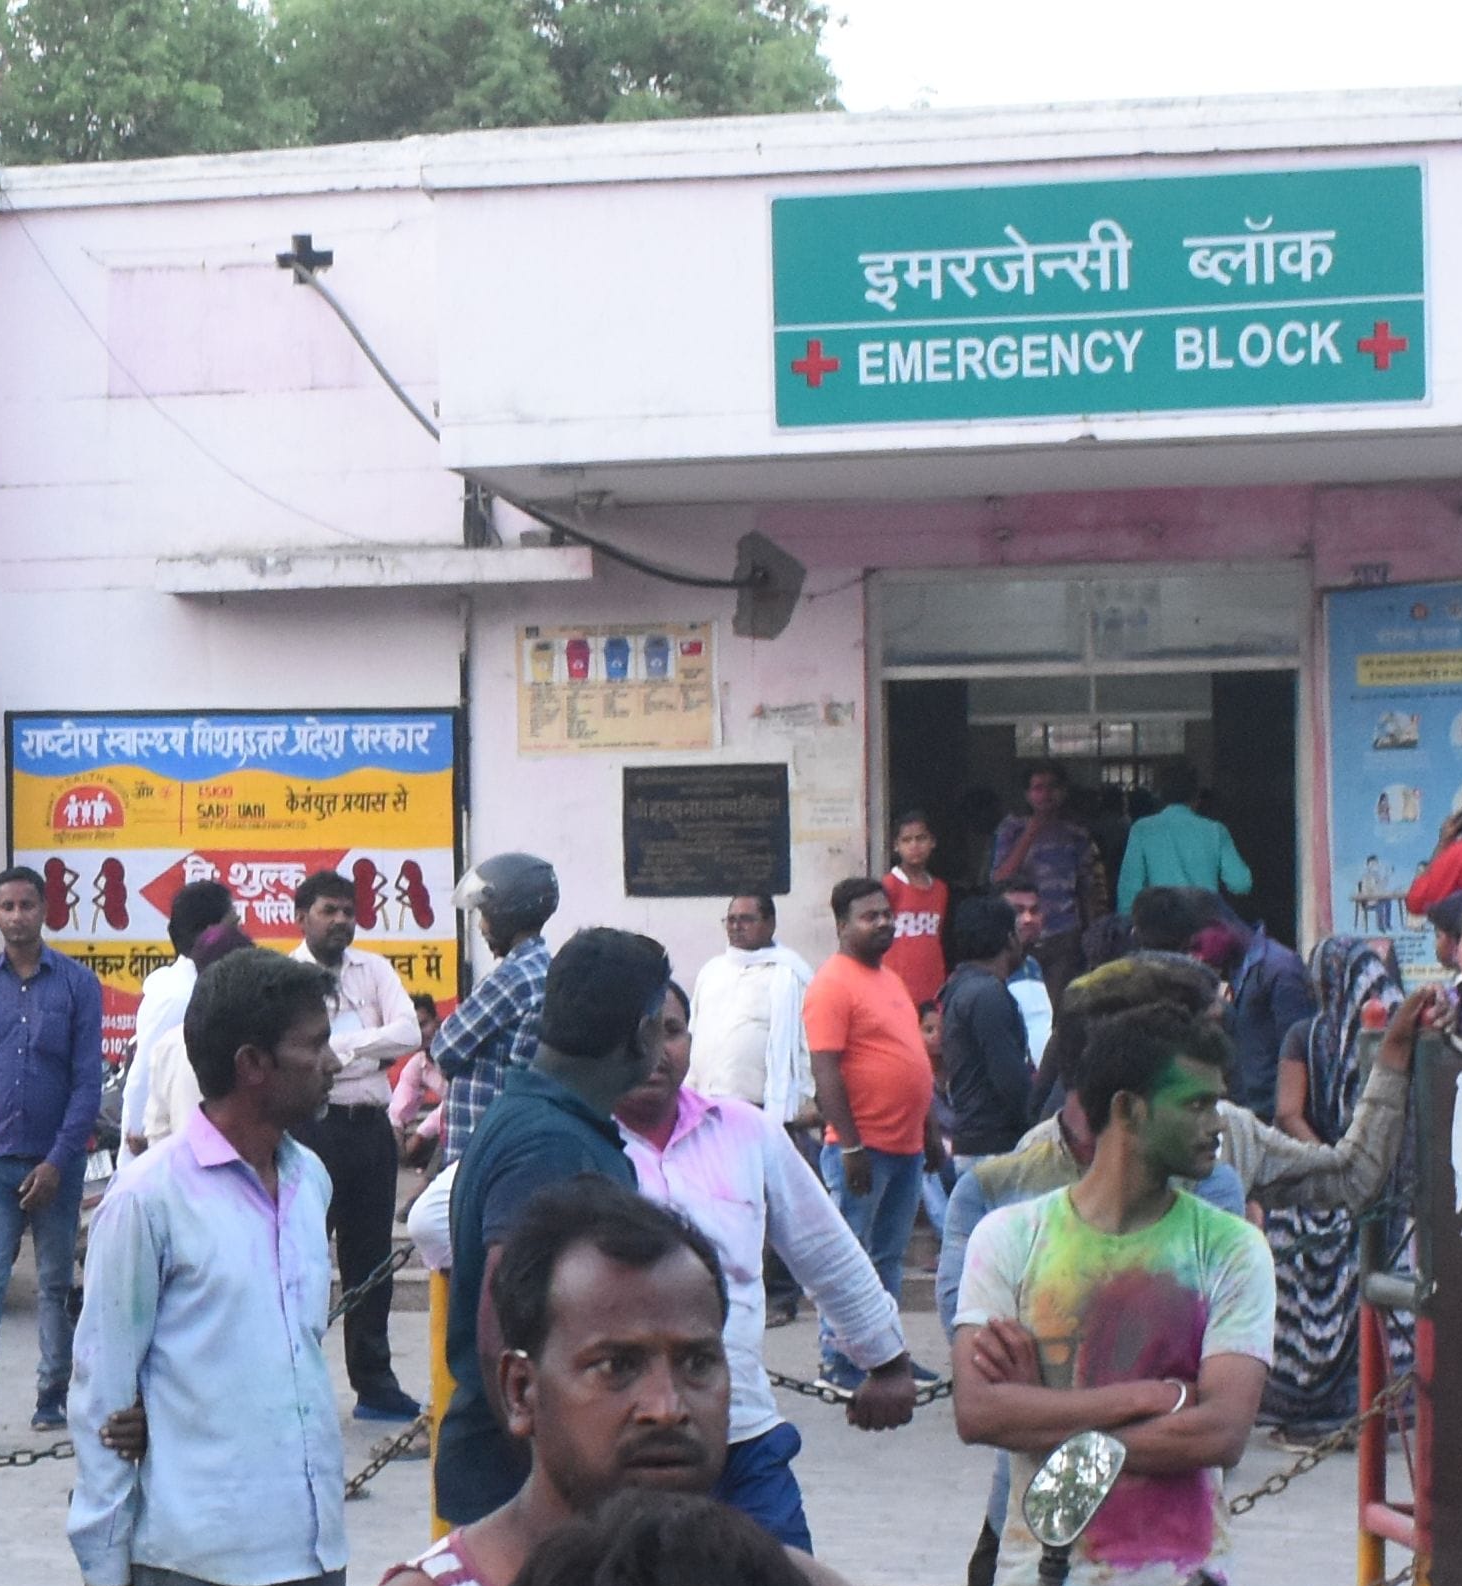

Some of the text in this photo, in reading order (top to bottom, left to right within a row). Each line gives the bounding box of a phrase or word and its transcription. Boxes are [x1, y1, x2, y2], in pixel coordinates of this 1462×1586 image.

[858, 216, 1336, 310] इमरजेन्सी ब्लॉक
[857, 320, 1342, 387] EMERGENCY BLOCK
[352, 722, 437, 755] सरकार
